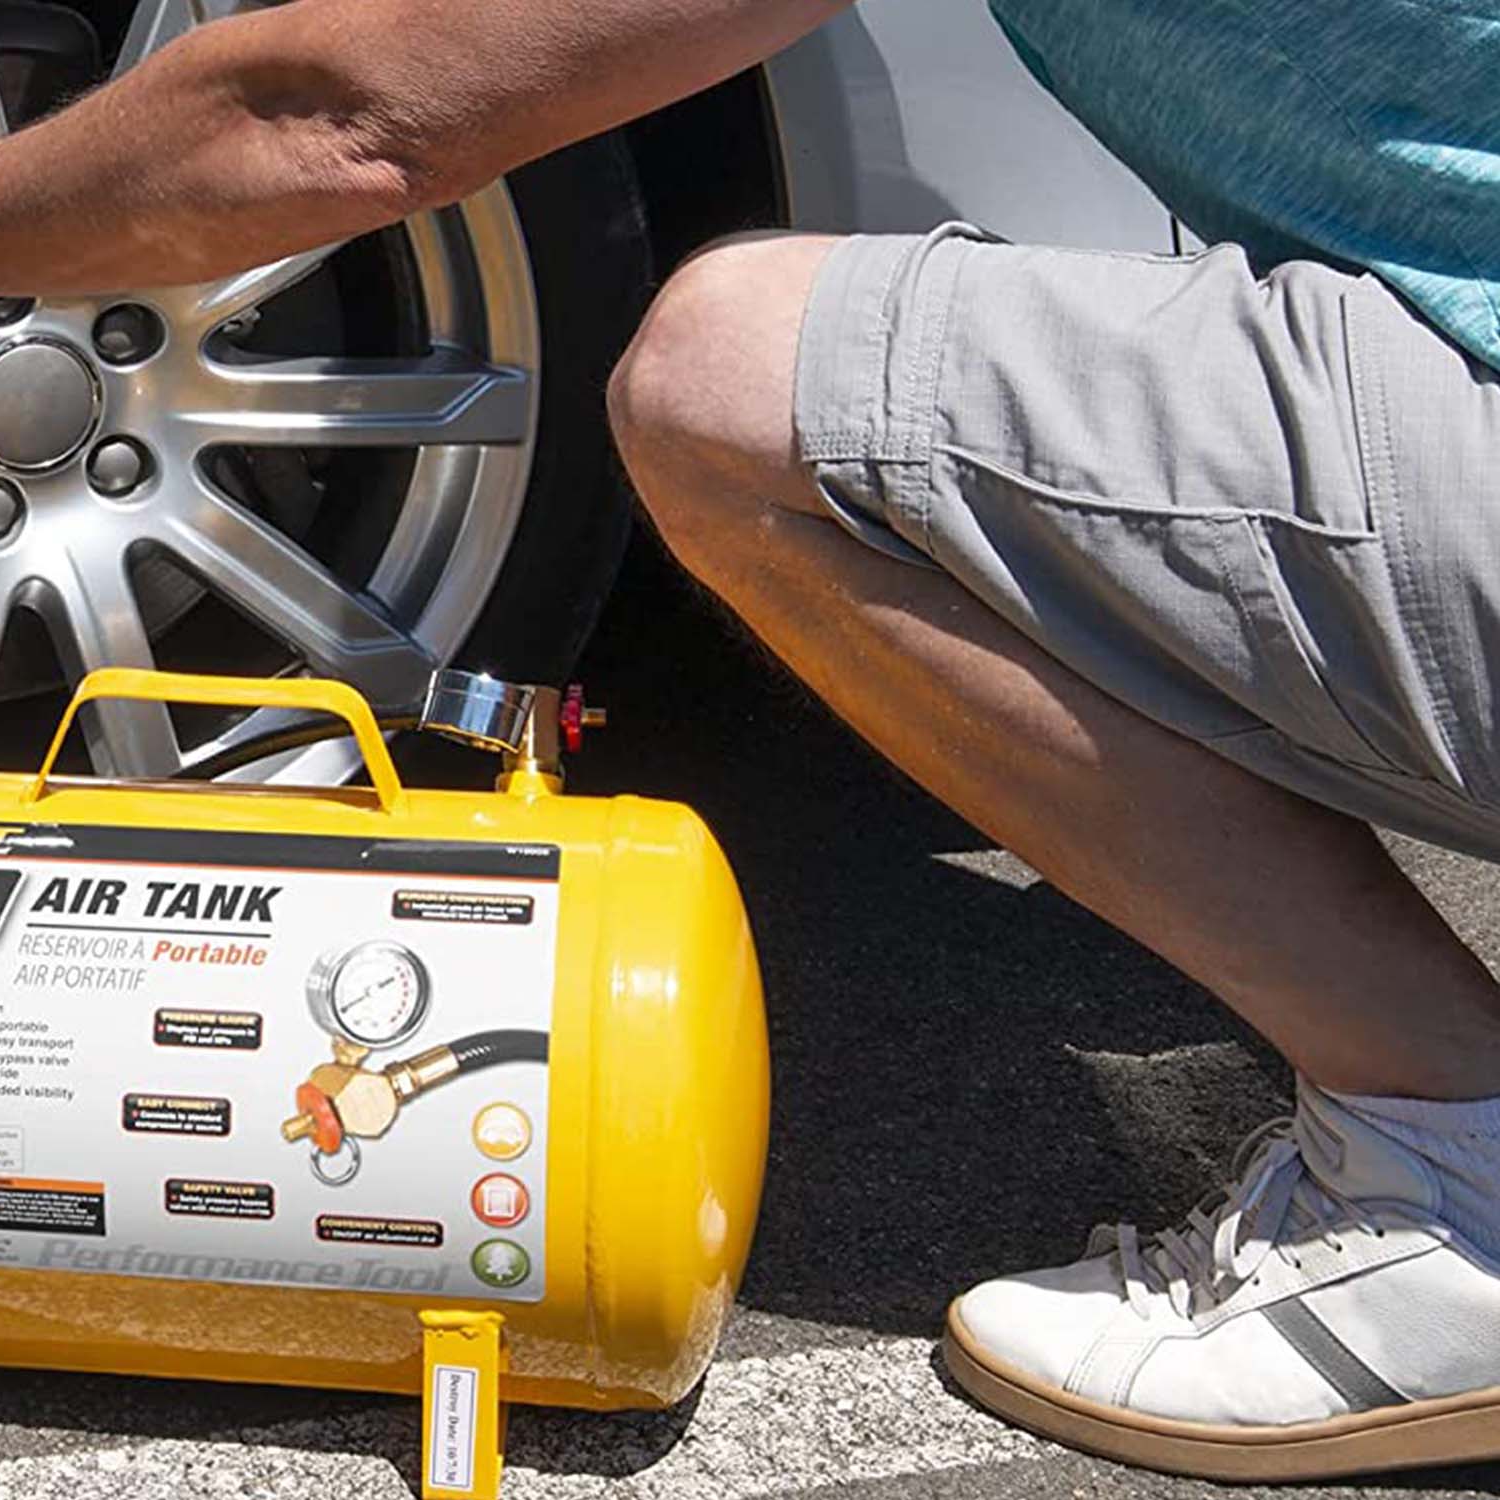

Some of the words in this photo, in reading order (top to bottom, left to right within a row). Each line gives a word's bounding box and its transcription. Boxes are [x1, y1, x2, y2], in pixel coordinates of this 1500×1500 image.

[30, 876, 128, 916] AIR
[142, 881, 284, 923] TANK
[152, 939, 268, 966] Portable
[13, 963, 49, 986] AIR
[51, 964, 148, 991] PORTATIF
[0, 1021, 49, 1033] portable
[19, 1037, 74, 1050] transport
[38, 1054, 70, 1066] valve
[25, 1086, 74, 1100] visibility
[36, 1237, 345, 1286] Performance
[352, 1256, 451, 1292] Tool
[446, 1374, 461, 1413] Destroy
